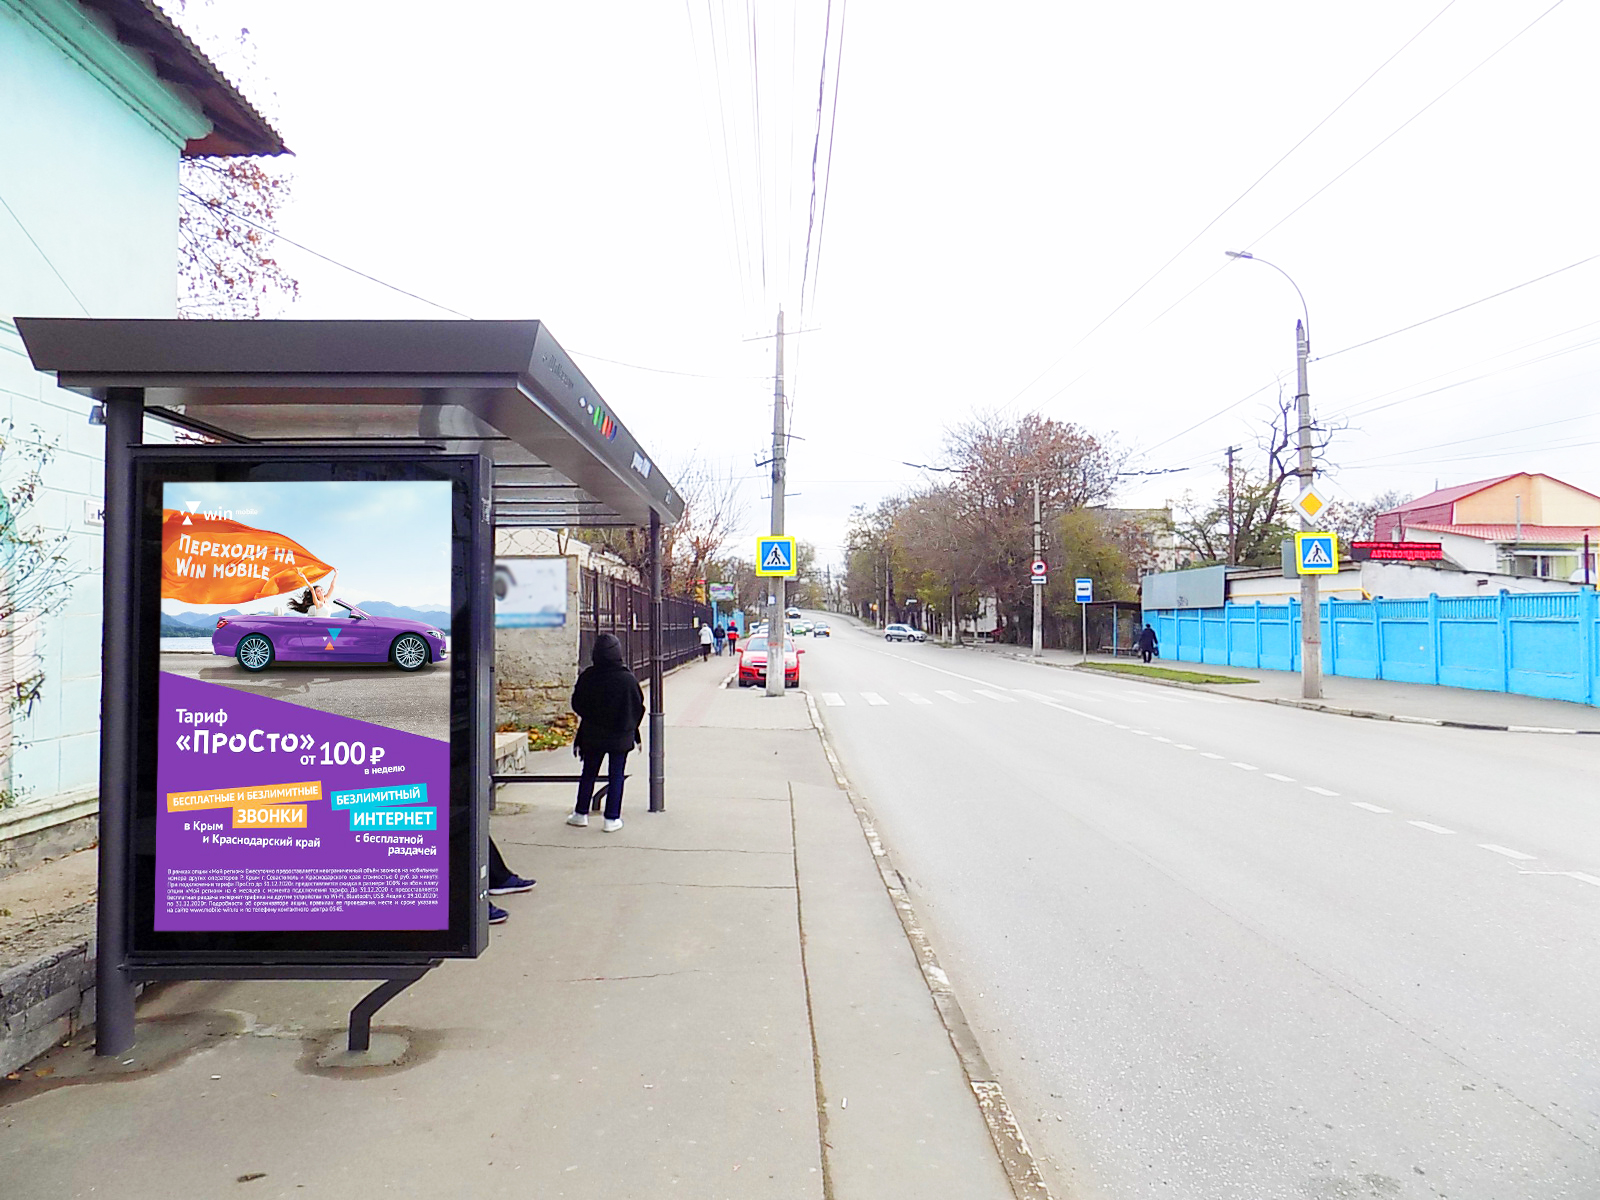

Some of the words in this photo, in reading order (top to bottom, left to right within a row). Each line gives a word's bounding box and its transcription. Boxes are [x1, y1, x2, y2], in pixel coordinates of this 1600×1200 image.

[203, 506, 233, 521] win
[176, 708, 228, 727] Тариф
[300, 753, 316, 765] от
[320, 741, 366, 765] 100
[364, 767, 370, 775] в
[371, 764, 406, 775] неделю
[173, 791, 236, 806] БЕСПЛАТНЫЕ
[237, 791, 245, 801] И
[246, 785, 319, 800] БЕЗЛИМИТНЫЕ
[336, 787, 421, 805] БЕЗЛИМИТНЫЙ
[237, 808, 303, 823] ЗВОНКИ
[353, 811, 434, 826] ИНТЕРНЕТ
[184, 822, 190, 831] в
[193, 820, 223, 833] Крым
[202, 834, 209, 843] и
[212, 833, 293, 848] Краснодарский
[295, 838, 321, 849] край
[355, 835, 361, 843] с
[363, 832, 423, 846] бесплатной
[388, 844, 437, 858] раздачей
